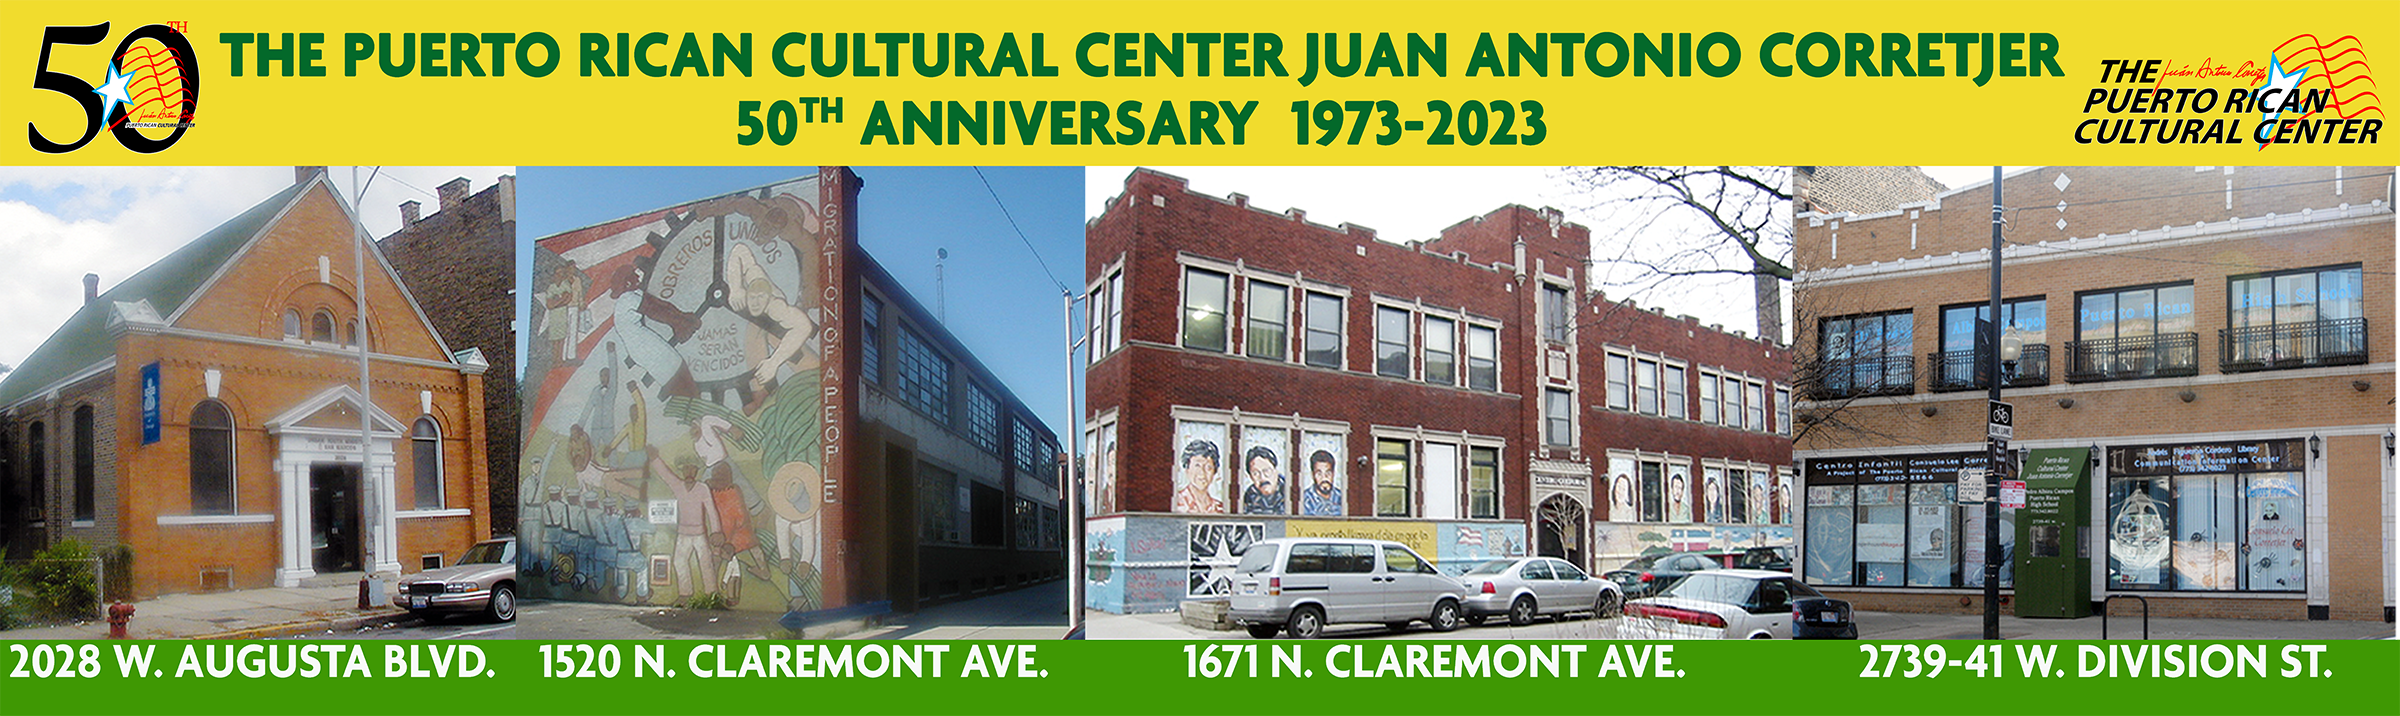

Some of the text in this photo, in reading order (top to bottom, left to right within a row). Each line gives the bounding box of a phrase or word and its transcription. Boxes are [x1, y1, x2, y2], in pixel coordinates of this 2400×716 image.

[659, 221, 782, 299] OBREROS UNIOS
[2241, 283, 2352, 309] High School
[2080, 302, 2191, 322] Puerto Rican
[697, 323, 738, 342] JAMAS
[821, 168, 840, 503] MIGRATION OF A PEOPLE
[1952, 320, 1973, 334] Alb
[697, 338, 739, 356] SERAN
[687, 350, 745, 372] VENCIDOS
[2238, 445, 2260, 454] Library
[2251, 455, 2280, 463] Center
[1816, 462, 1854, 470] Centro
[1858, 459, 1903, 468] Infantil
